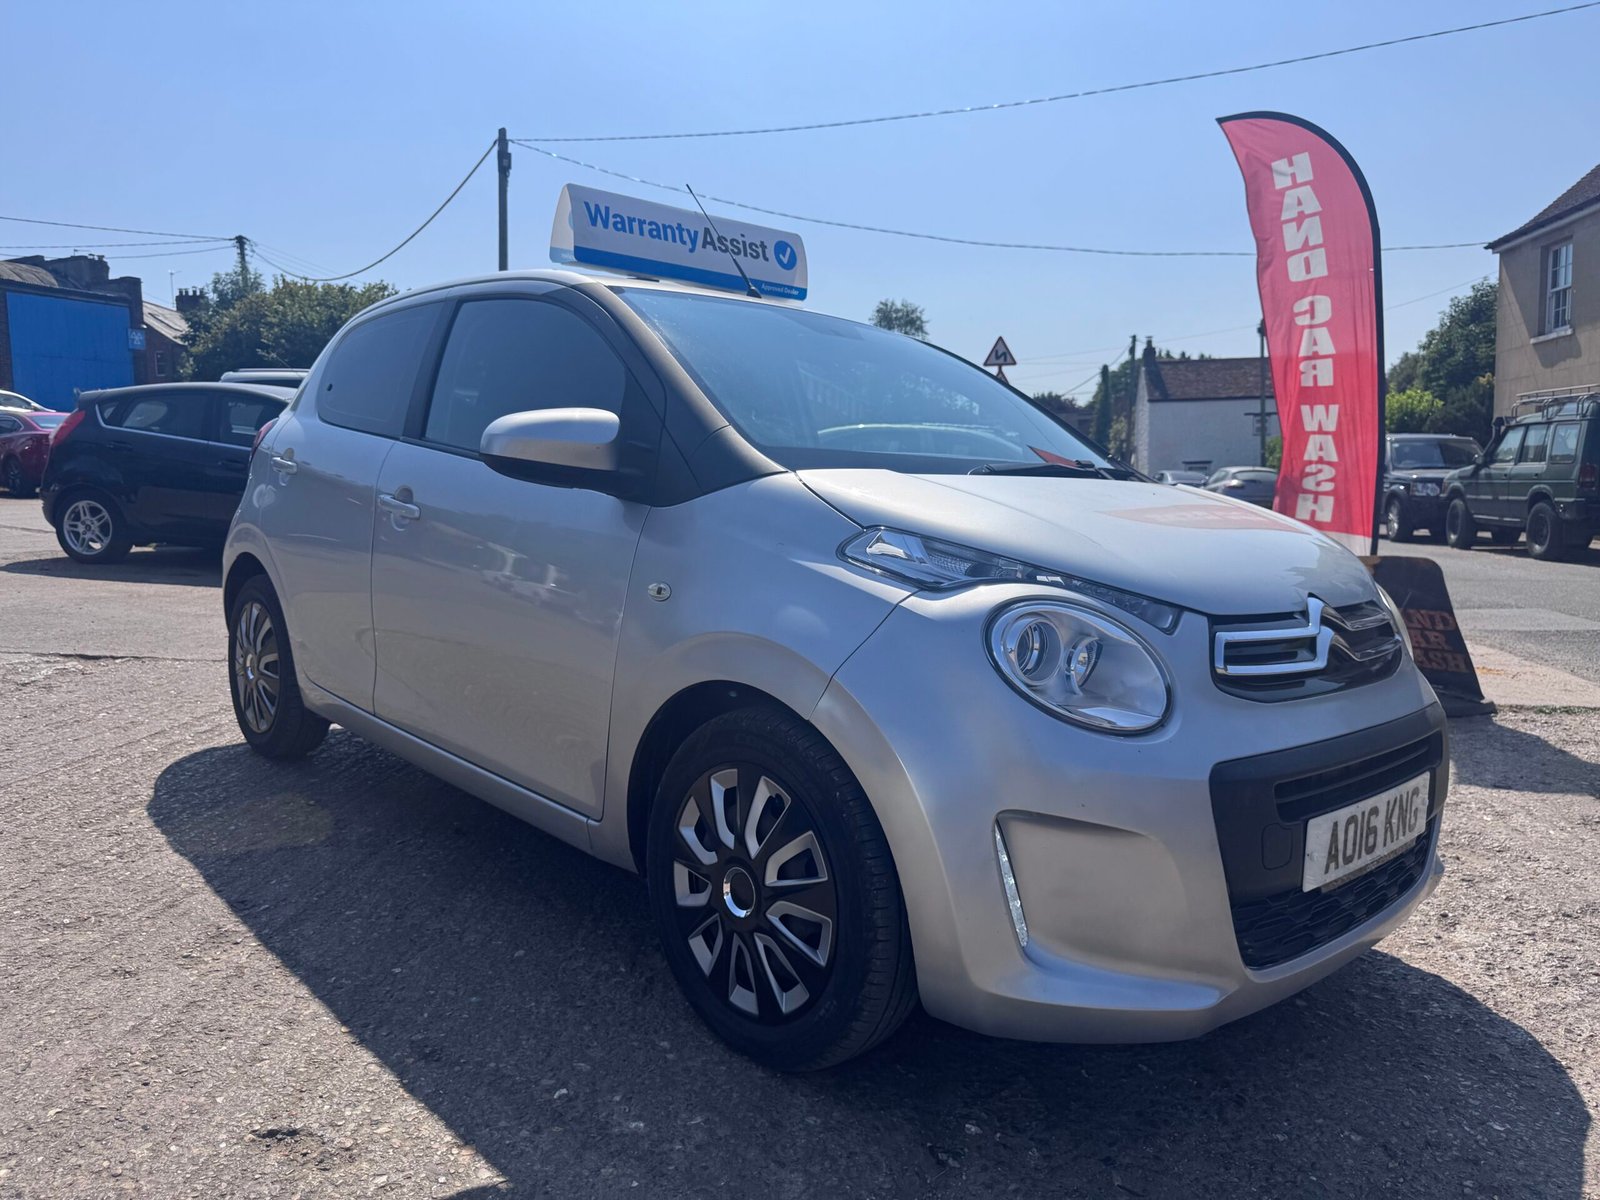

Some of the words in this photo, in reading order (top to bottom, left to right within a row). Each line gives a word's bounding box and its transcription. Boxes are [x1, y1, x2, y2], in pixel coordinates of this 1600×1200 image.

[1408, 629, 1453, 651] AR
[1413, 648, 1470, 673] ASH
[1324, 805, 1380, 875] AO16
[1383, 786, 1420, 848] KNG
